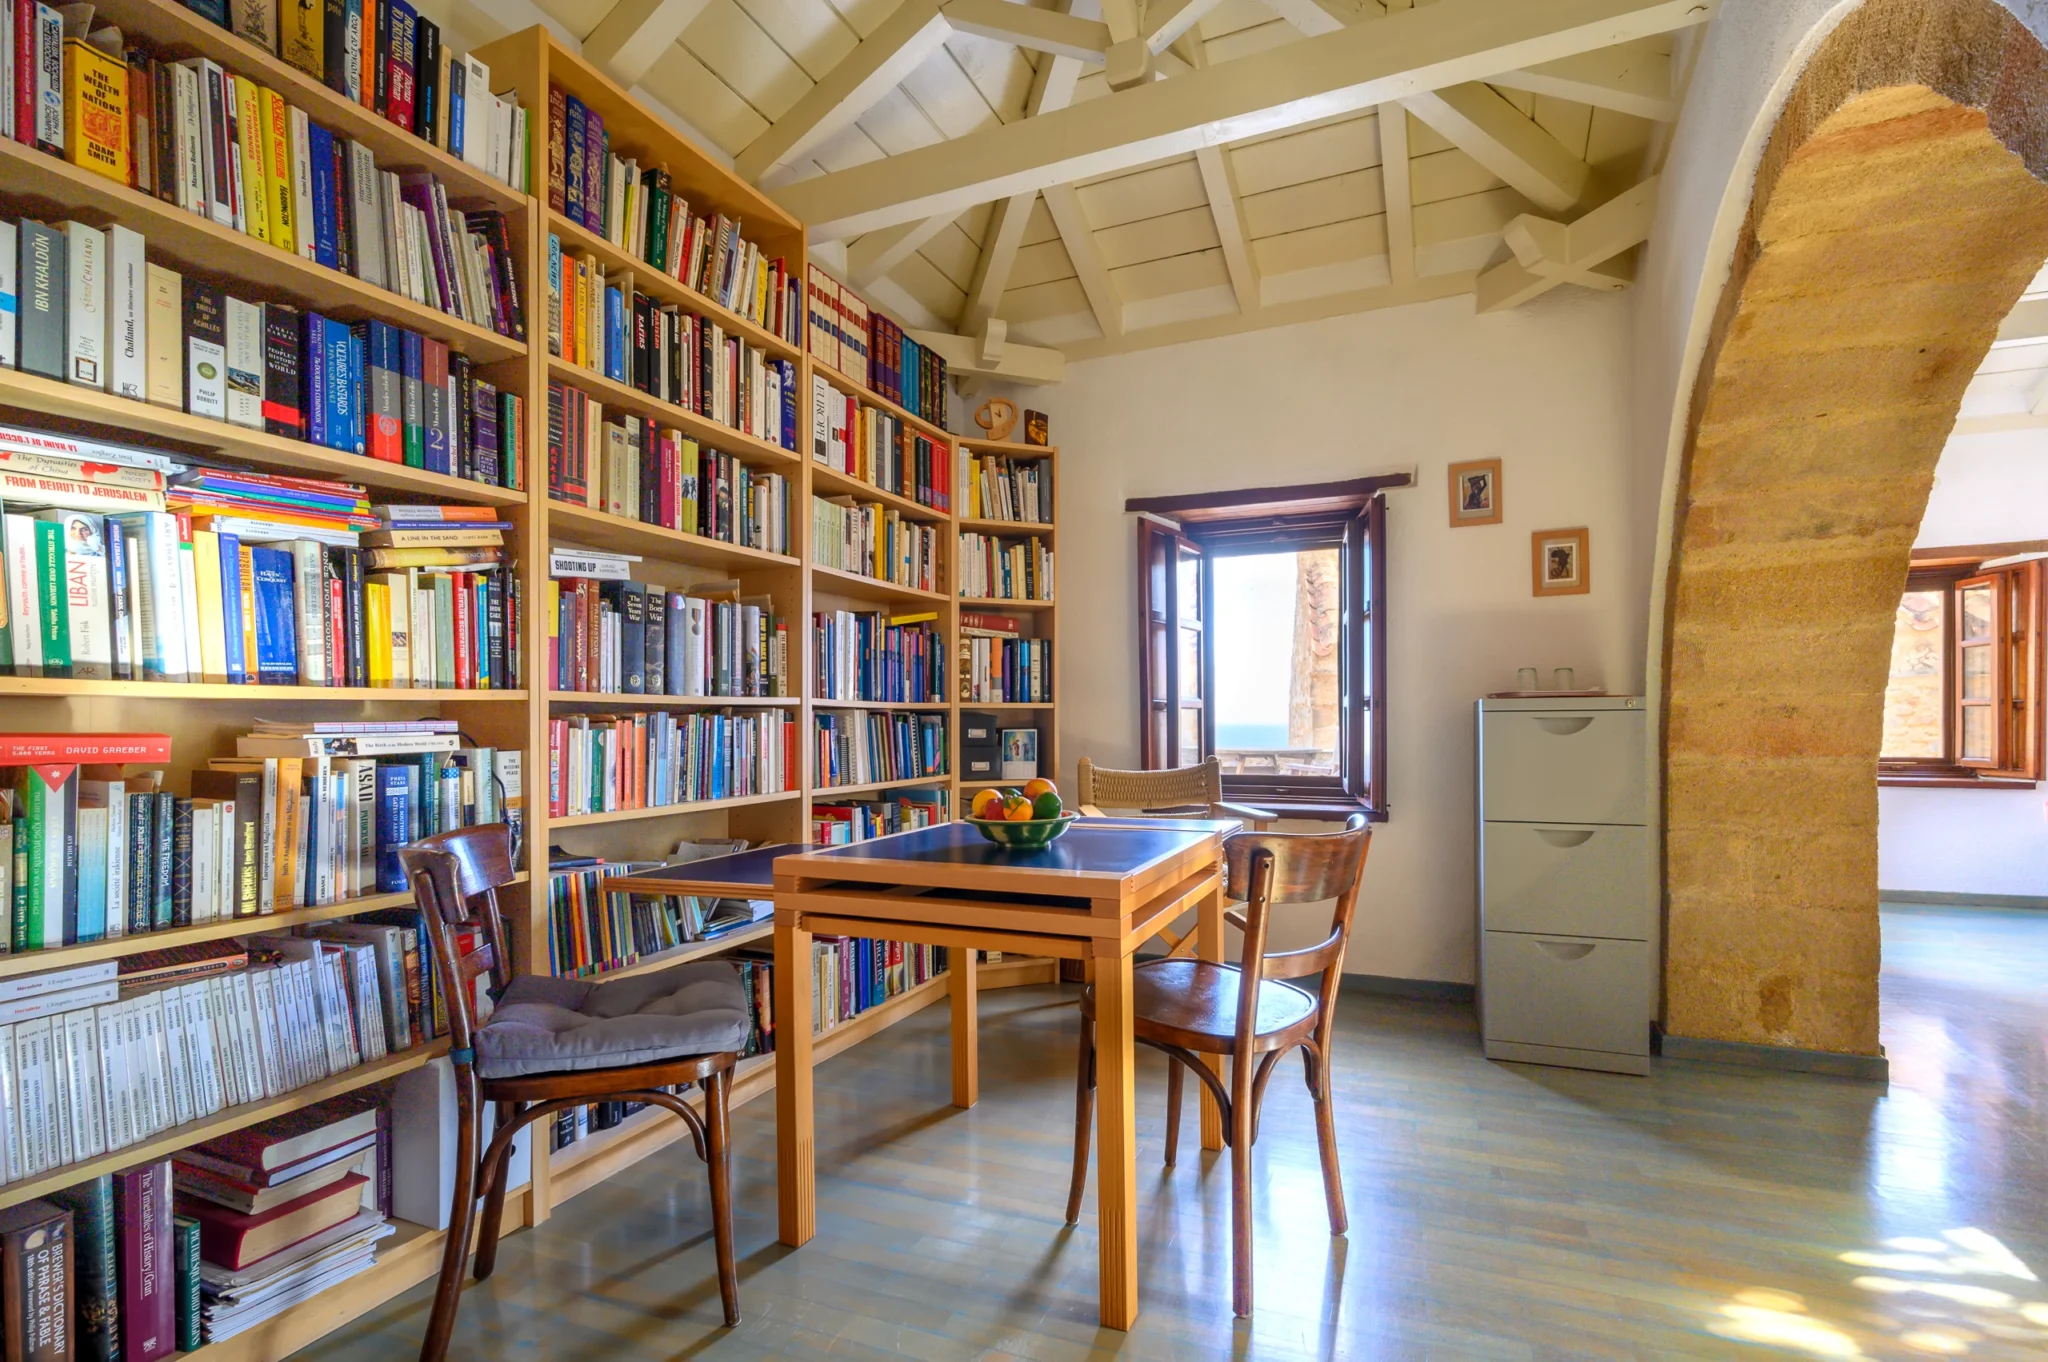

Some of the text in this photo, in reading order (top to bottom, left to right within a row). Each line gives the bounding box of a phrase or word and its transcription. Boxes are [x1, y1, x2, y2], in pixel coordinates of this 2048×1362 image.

[390, 6, 403, 62] TO JERUSALEM
[404, 14, 414, 68] FROM BEIRUT
[84, 74, 120, 97] WEALTH
[92, 69, 109, 84] THE
[393, 65, 402, 100] Friedman
[404, 73, 412, 104] Thomas
[82, 91, 122, 116] NATIONS
[95, 90, 107, 99] OF
[273, 94, 285, 139] SOCIALISM
[88, 141, 116, 158] ADAM
[246, 114, 255, 161] TYRANNIES
[87, 150, 116, 167] SMITH
[31, 233, 49, 312] IBN KHALDÛN
[82, 237, 93, 282] CHALIAND
[125, 319, 135, 358] Chaliand,
[193, 319, 221, 333] ACHILLES
[268, 353, 296, 366] HISTORY
[269, 362, 296, 376] WORLD
[337, 379, 348, 415] BASTARDS
[816, 384, 825, 441] EUROPE
[36, 457, 77, 467] Dynasties
[41, 465, 69, 475] China
[5, 475, 148, 503] FROM BEIRUT TO JERUSALEM
[555, 560, 586, 572] SHOOTING
[49, 582, 57, 606] LEBANON
[67, 561, 89, 607] LIBAN
[650, 613, 662, 622] War
[66, 746, 147, 754] DAVID GRAEBER
[358, 765, 373, 802] ASAD
[33, 822, 43, 867] KING HUSSEIN
[160, 836, 170, 887] THE FREEDOM
[142, 1170, 154, 1188] The
[142, 1189, 154, 1232] Timetables
[27, 1268, 35, 1288] edition
[189, 1229, 200, 1346] PICTURESQUE WORD ORIGINS
[38, 1249, 51, 1347] OF PHRASE & FABLE
[52, 1243, 65, 1355] BREWER'S DICTIONARY
[27, 1320, 36, 1333] Philip
[28, 1333, 36, 1353] Pullman
